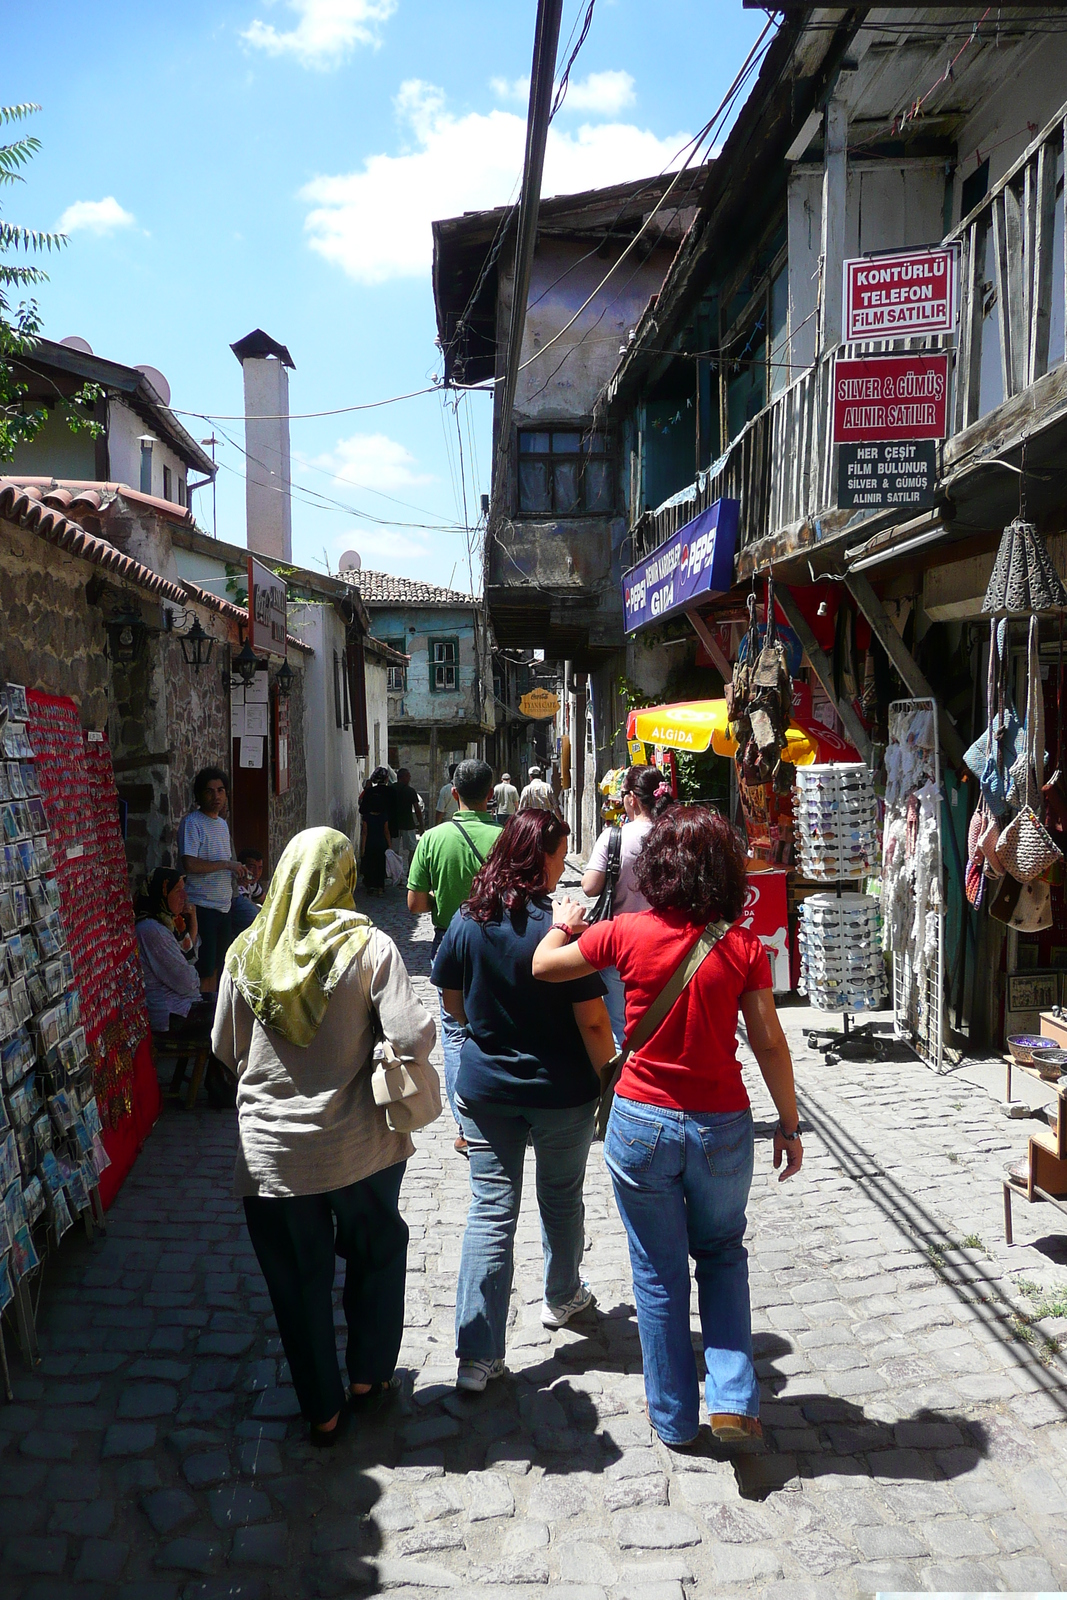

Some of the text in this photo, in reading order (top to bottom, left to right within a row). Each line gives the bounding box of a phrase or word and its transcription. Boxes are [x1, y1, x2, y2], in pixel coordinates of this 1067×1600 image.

[857, 259, 945, 286] KONTÜRLÜ
[861, 284, 933, 306] TELEFON
[887, 303, 946, 324] SATILIR
[838, 370, 944, 401] SILVER & GÜMÜŞ
[843, 404, 937, 428] ALINIR SATILIR
[857, 444, 917, 462] HER ÇEŞİT
[847, 461, 928, 475] FİLM BULUNUR
[847, 476, 928, 490] SİLVER & GÜMÜŞ
[853, 492, 920, 504] ALINIR SATILIR
[687, 527, 717, 578] PEPSI
[630, 579, 646, 614] PEPSI
[650, 580, 674, 616] GIDA
